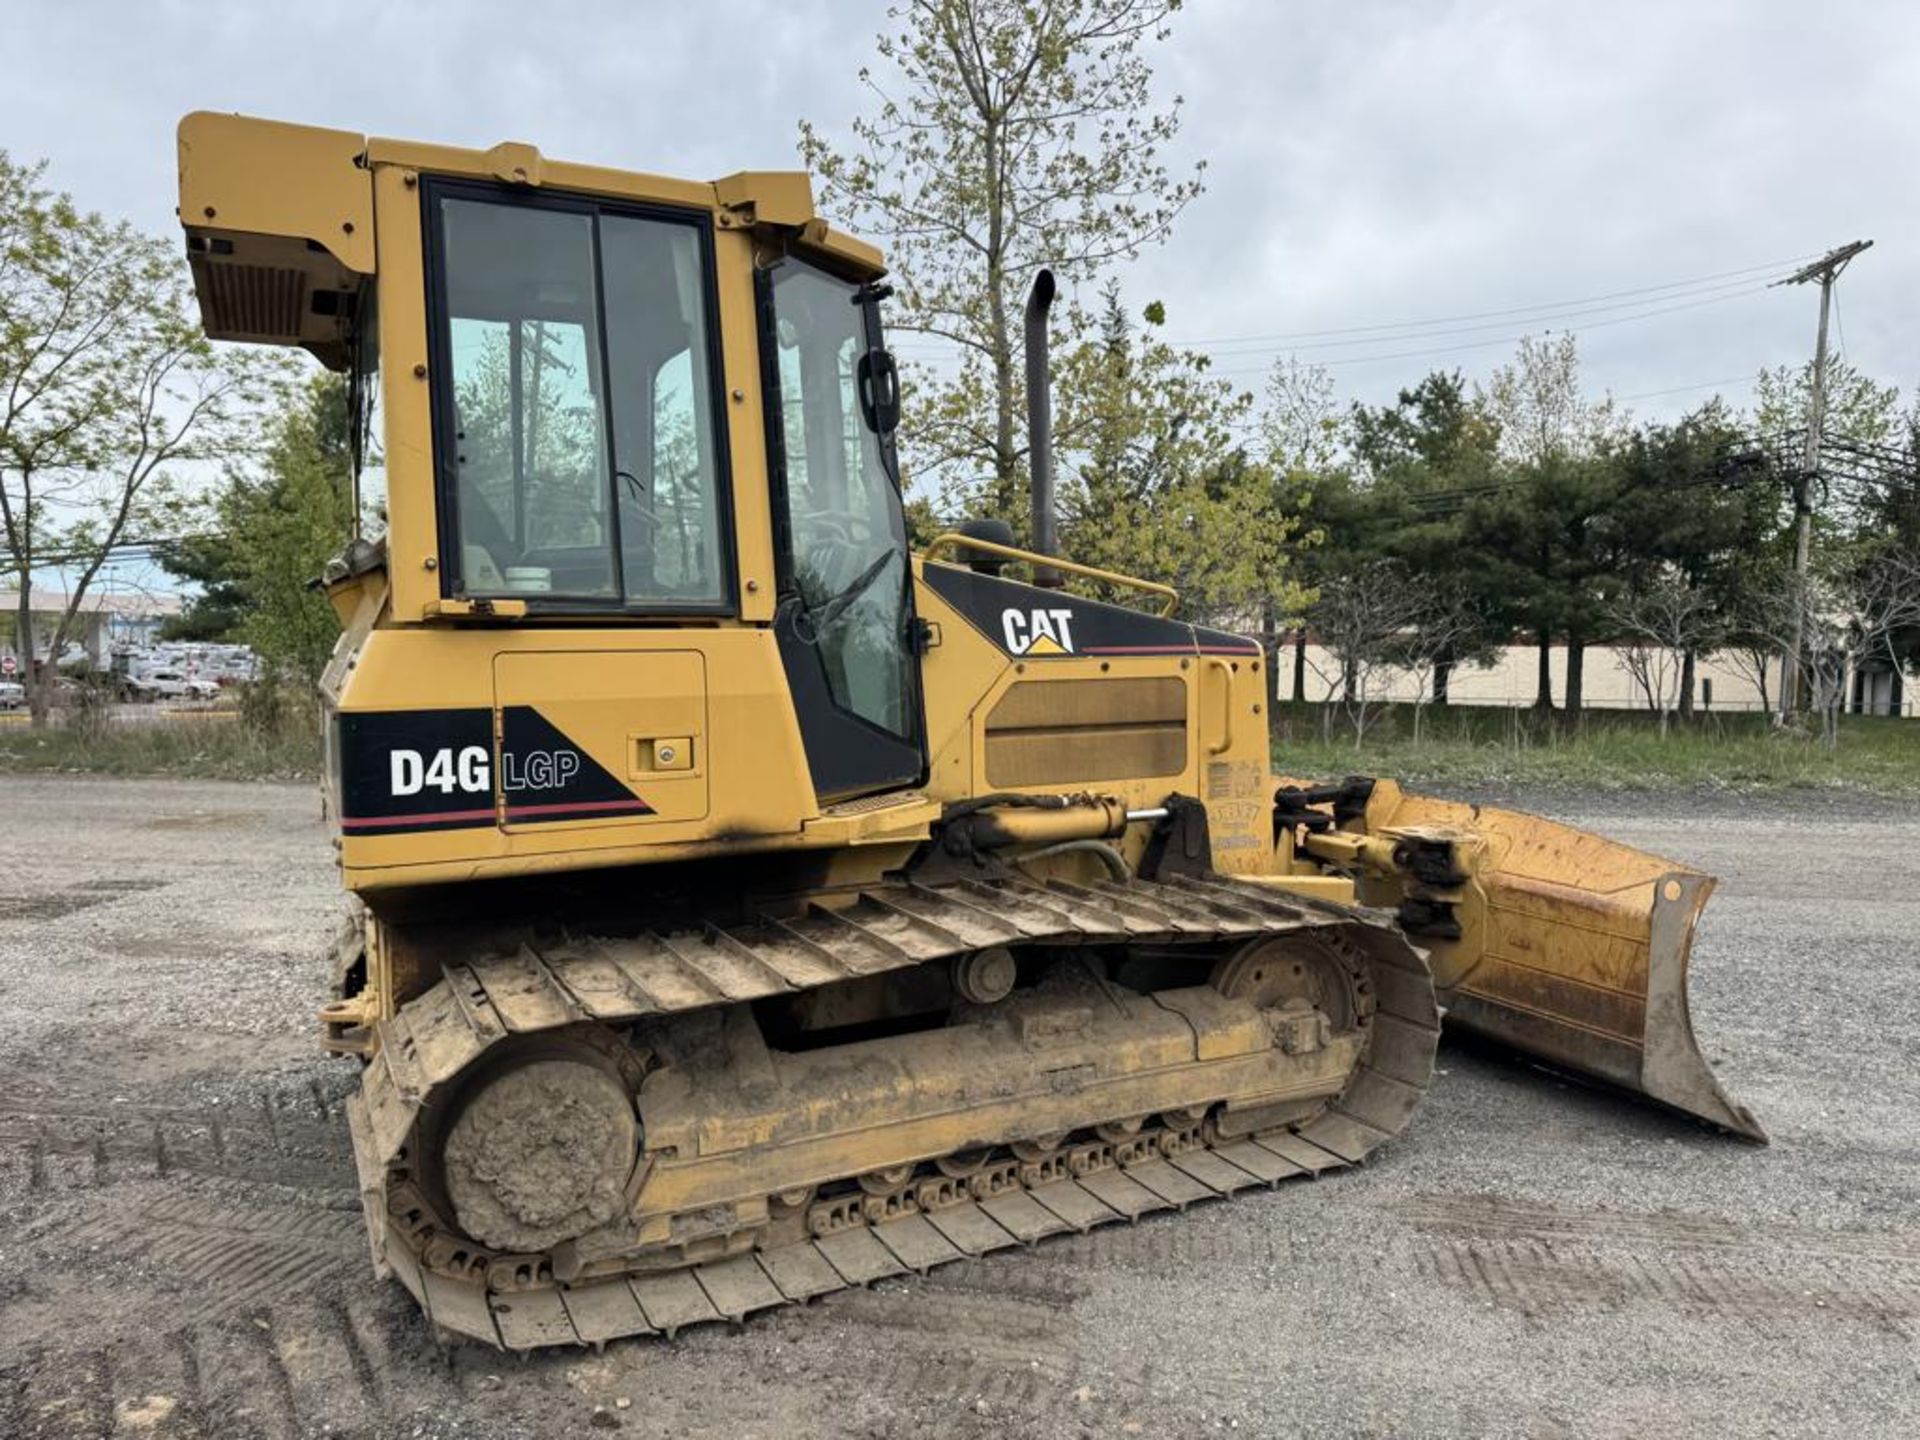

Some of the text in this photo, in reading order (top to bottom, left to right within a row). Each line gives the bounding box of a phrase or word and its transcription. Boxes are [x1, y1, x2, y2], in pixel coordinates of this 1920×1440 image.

[1002, 608, 1073, 654] CAT
[391, 746, 580, 796] D4G LGP
